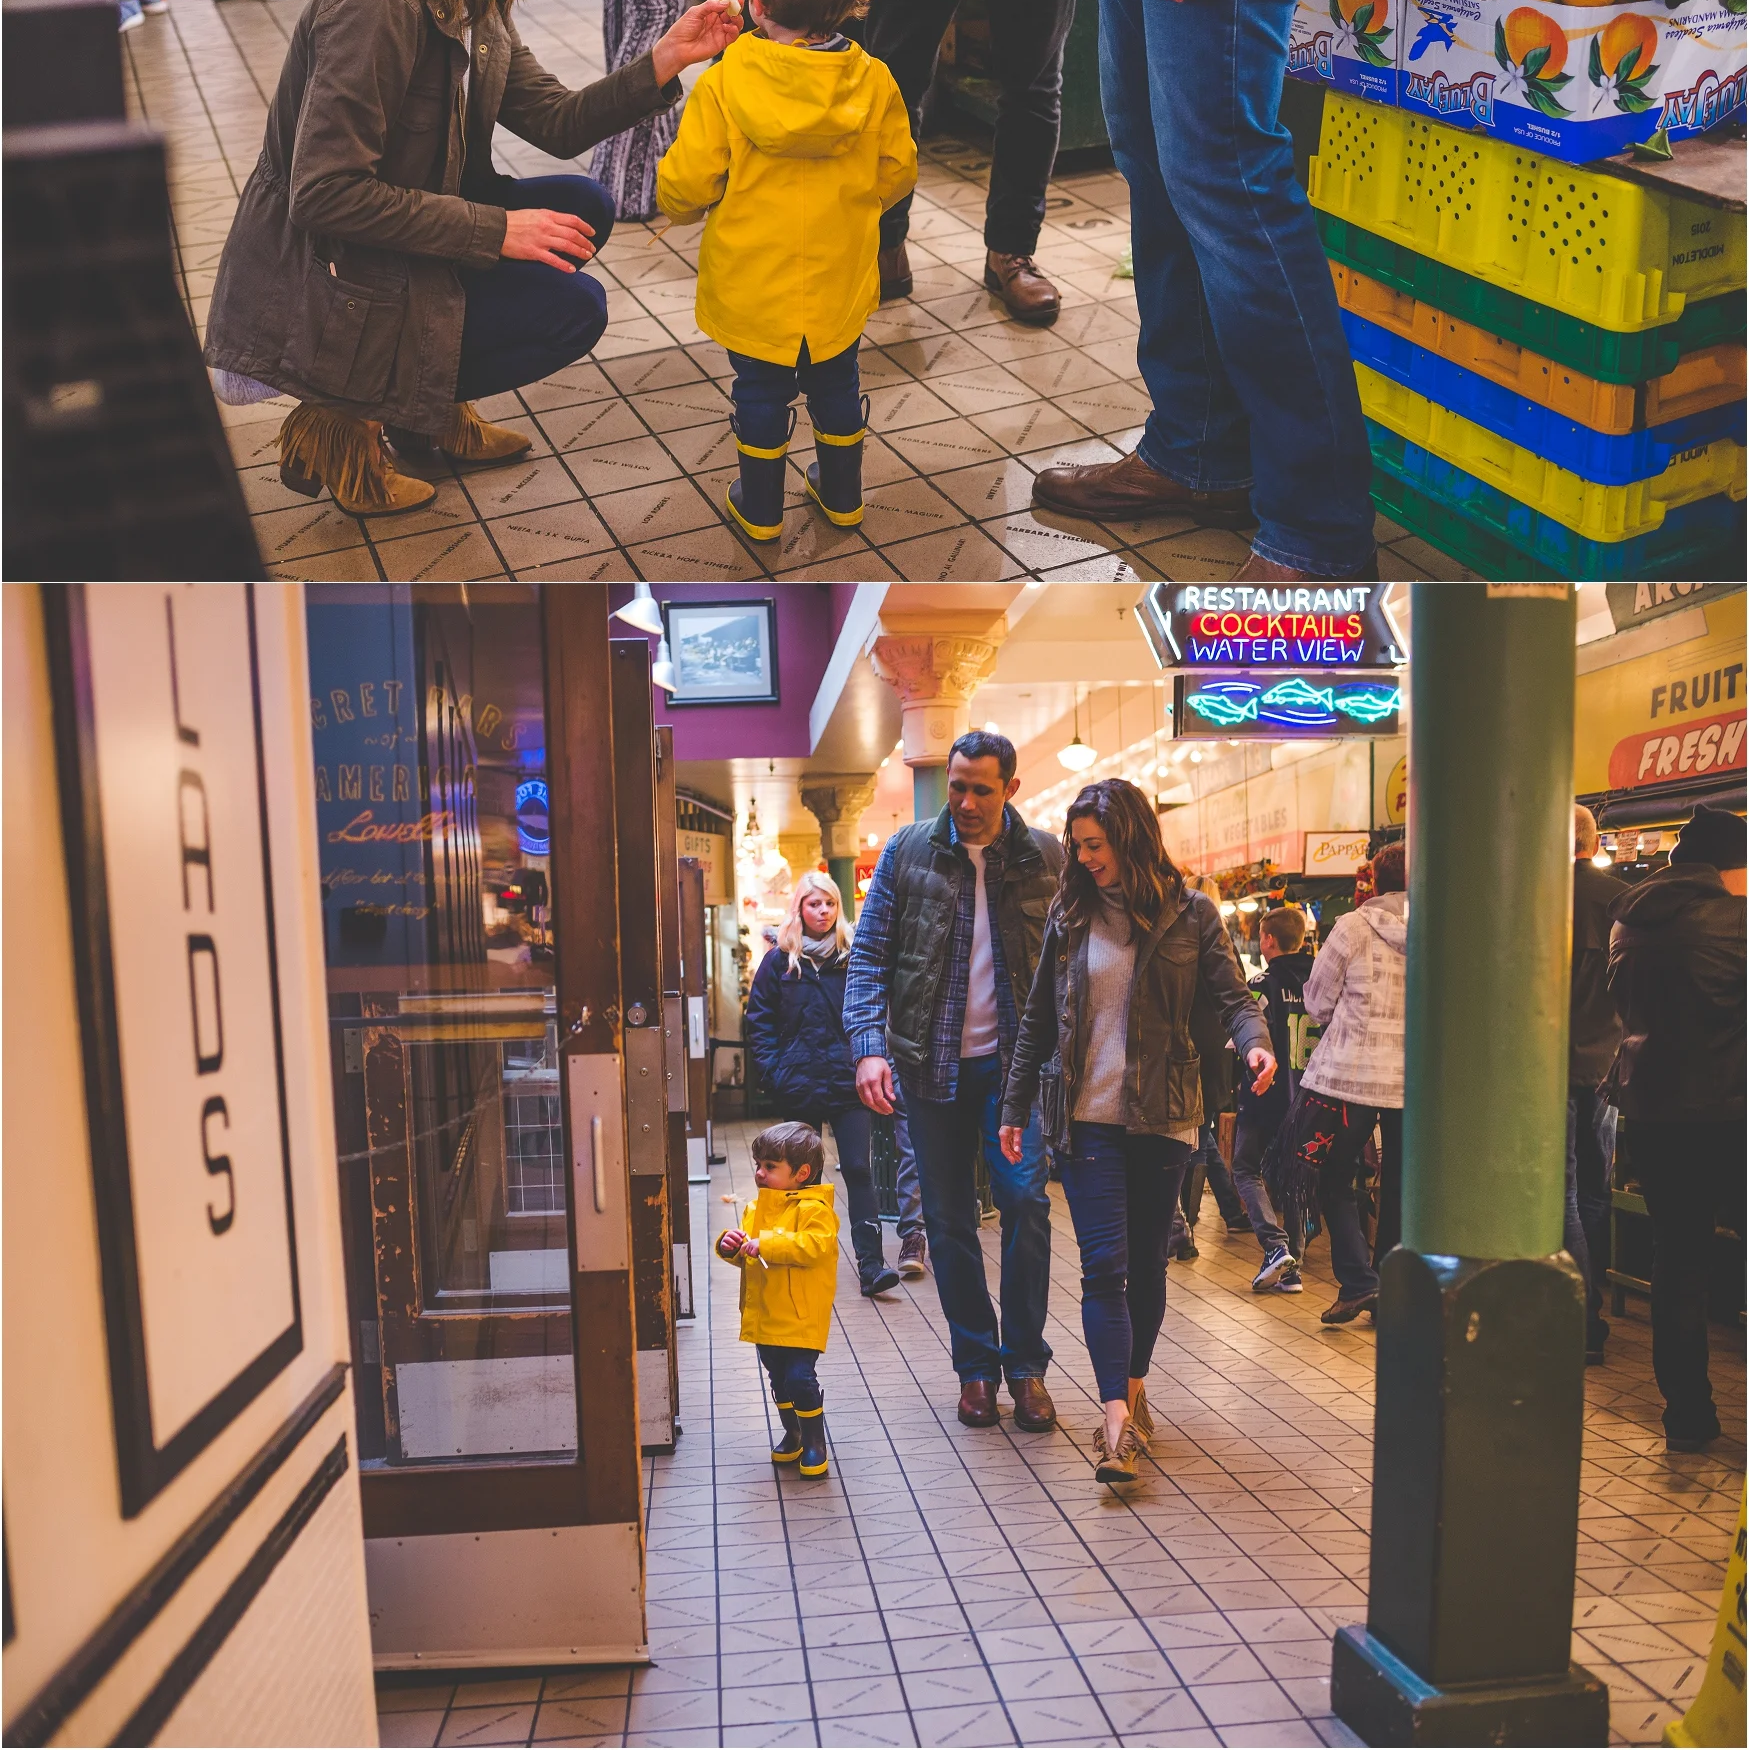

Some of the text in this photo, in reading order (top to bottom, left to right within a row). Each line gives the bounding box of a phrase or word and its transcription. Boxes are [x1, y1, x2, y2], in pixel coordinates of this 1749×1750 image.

[1440, 2, 1481, 21] California
[1668, 10, 1719, 28] MANDARINS
[1665, 25, 1706, 41] Seedless
[1513, 126, 1525, 135] USA
[1527, 122, 1550, 135] BUSHEL
[1534, 133, 1561, 147] PRODUCE
[1691, 221, 1711, 236] 2015
[1672, 244, 1724, 266] MIDDLETON
[644, 398, 675, 408] MARILYN
[685, 404, 726, 415] THOMPSON
[897, 436, 992, 454] THOMAS ADDIE DICKENS
[592, 458, 651, 472] GRACE WILSON
[650, 496, 671, 515] ROGERS
[864, 503, 945, 520] PATRICIA MAGUIRE
[564, 535, 590, 545] GUPTA
[1005, 526, 1050, 538] BARBARA
[275, 534, 298, 552] STUART
[641, 549, 744, 572] RICK&A HOPE 4THEBEST
[273, 572, 299, 582] JAMES
[1184, 586, 1372, 612] RESTAURANT
[1200, 613, 1363, 638] COCKTAILS
[1192, 638, 1365, 662] WATER VIEW
[1637, 719, 1747, 781] FRESH
[1224, 807, 1288, 843] VEGETABLES
[684, 835, 711, 853] GIFTS
